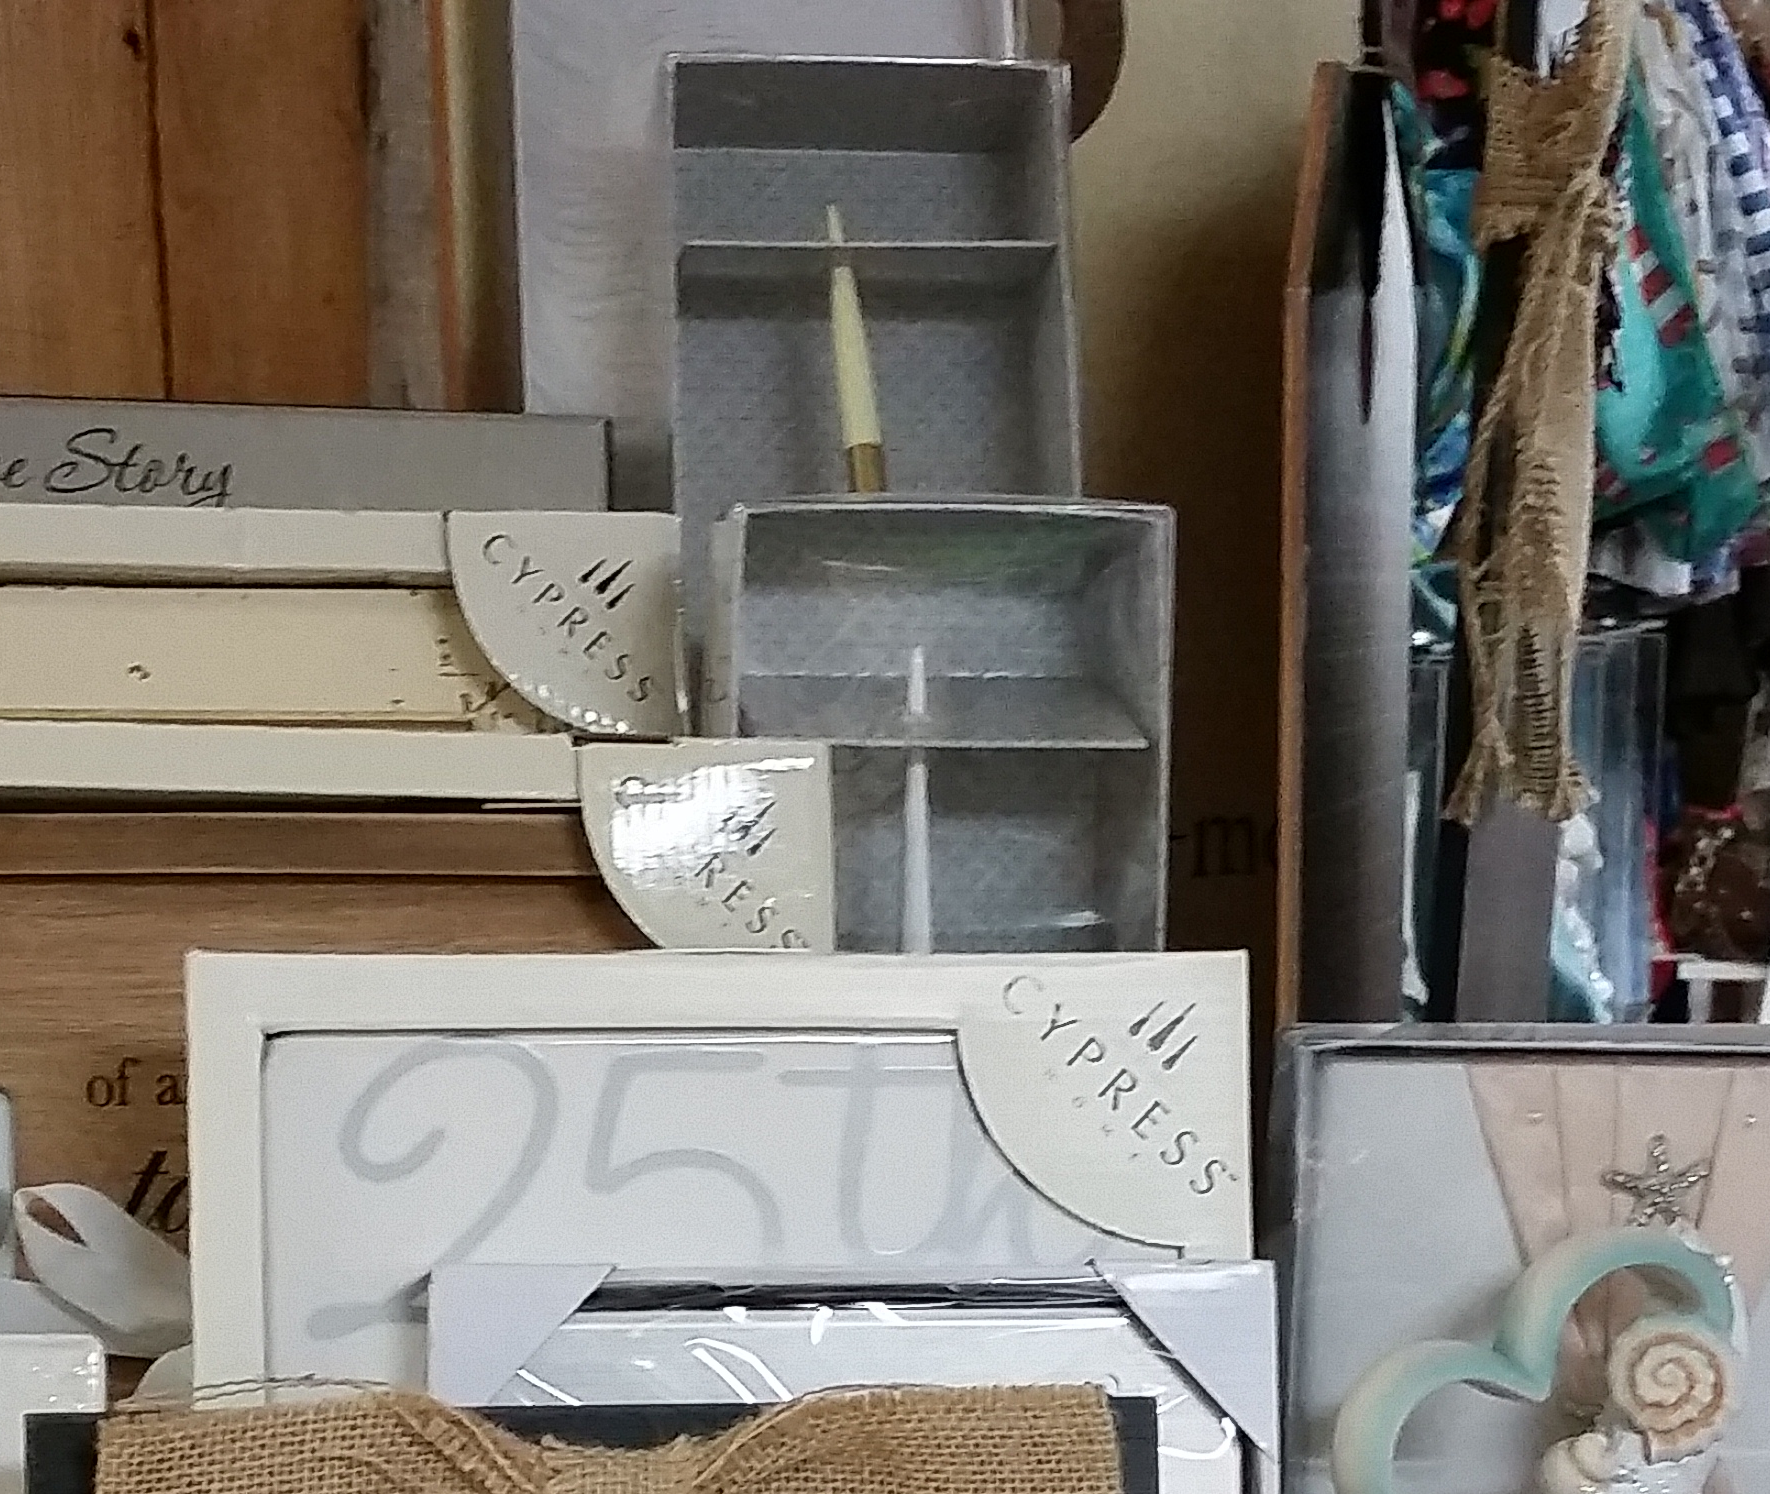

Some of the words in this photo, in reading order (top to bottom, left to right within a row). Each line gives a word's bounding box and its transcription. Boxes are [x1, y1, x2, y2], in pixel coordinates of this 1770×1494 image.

[43, 427, 233, 508] Story
[482, 534, 653, 702] CYPRESS
[85, 1058, 139, 1108] of
[1003, 975, 1228, 1194] CYPRESS
